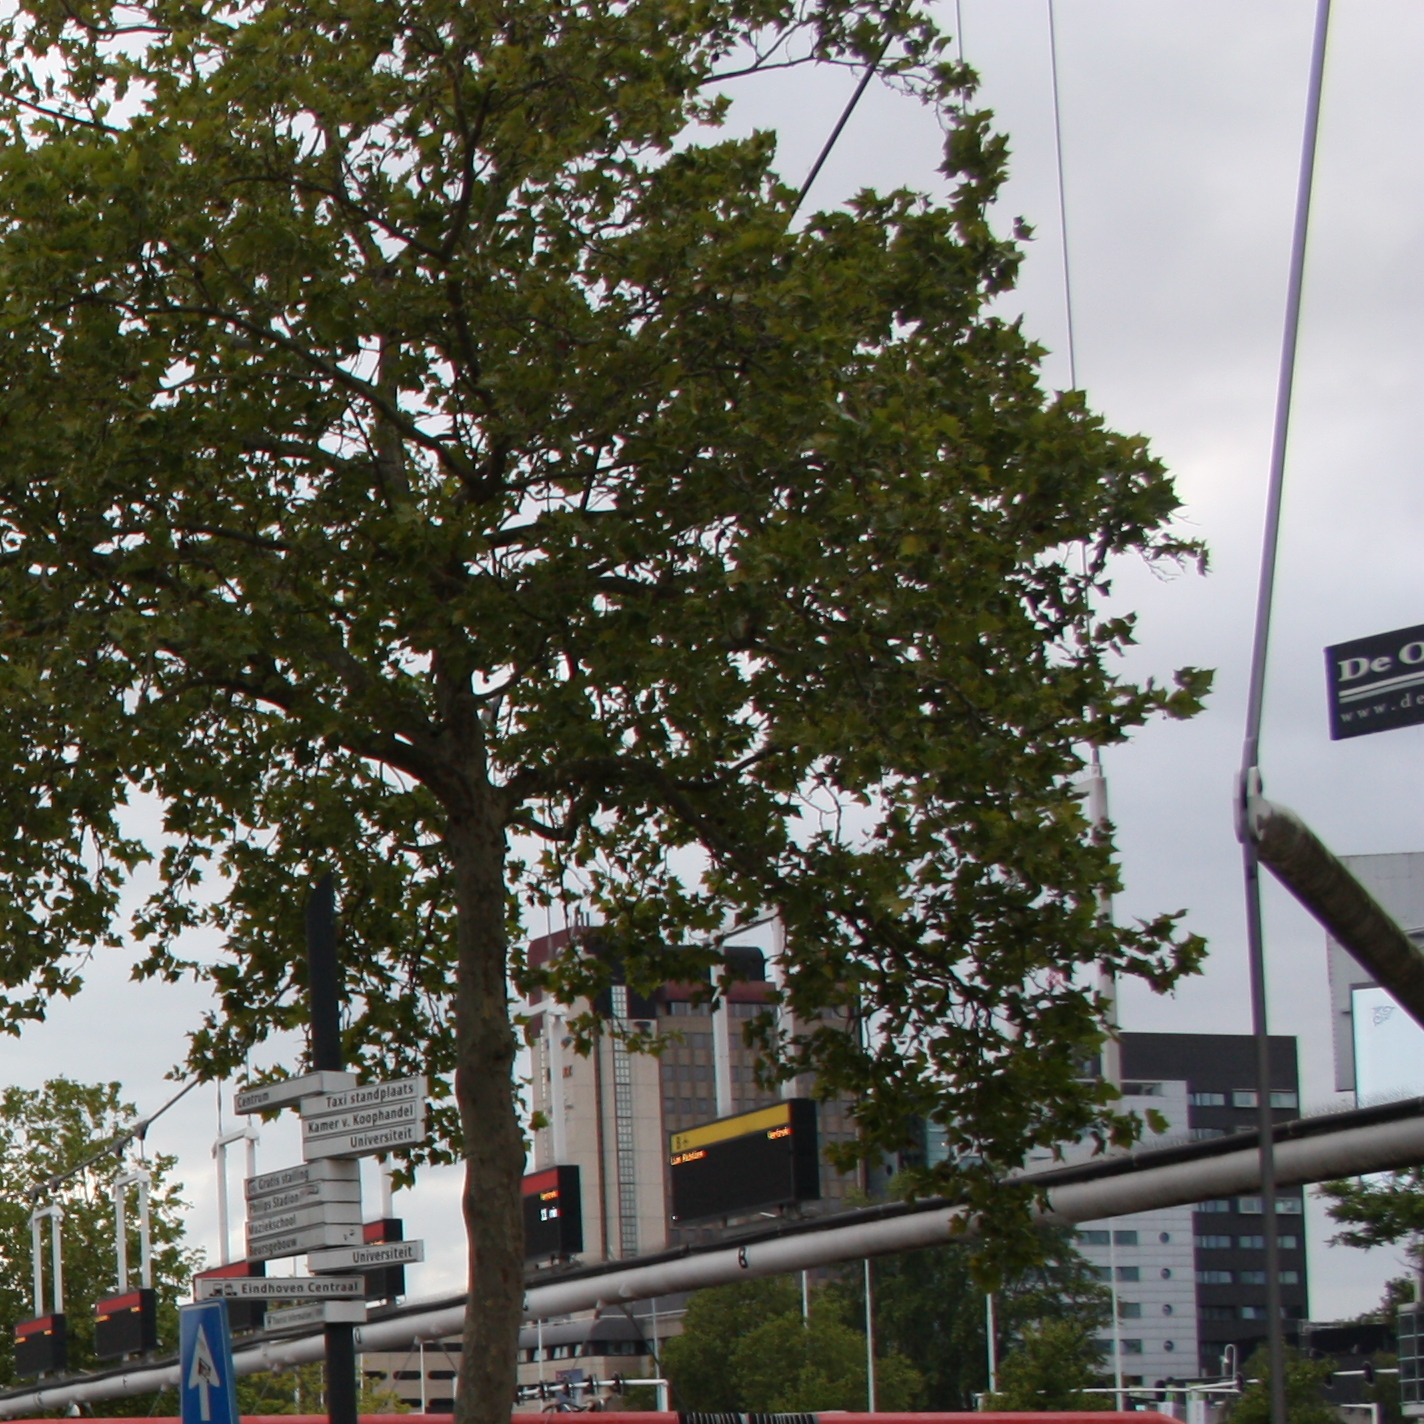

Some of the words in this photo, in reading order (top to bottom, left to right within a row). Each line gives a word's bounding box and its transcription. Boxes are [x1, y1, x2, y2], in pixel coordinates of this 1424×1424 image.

[1338, 656, 1392, 681] De
[237, 1091, 269, 1108] Centrum
[326, 1094, 347, 1109] Taxi
[351, 1083, 414, 1105] standplaats
[308, 1118, 339, 1134] Kamer
[353, 1104, 414, 1126] Koophandel
[350, 1127, 412, 1149] Universiteit
[353, 1245, 413, 1264] Universiteit
[241, 1282, 304, 1294] Eindhoven
[308, 1281, 358, 1293] Centraal
